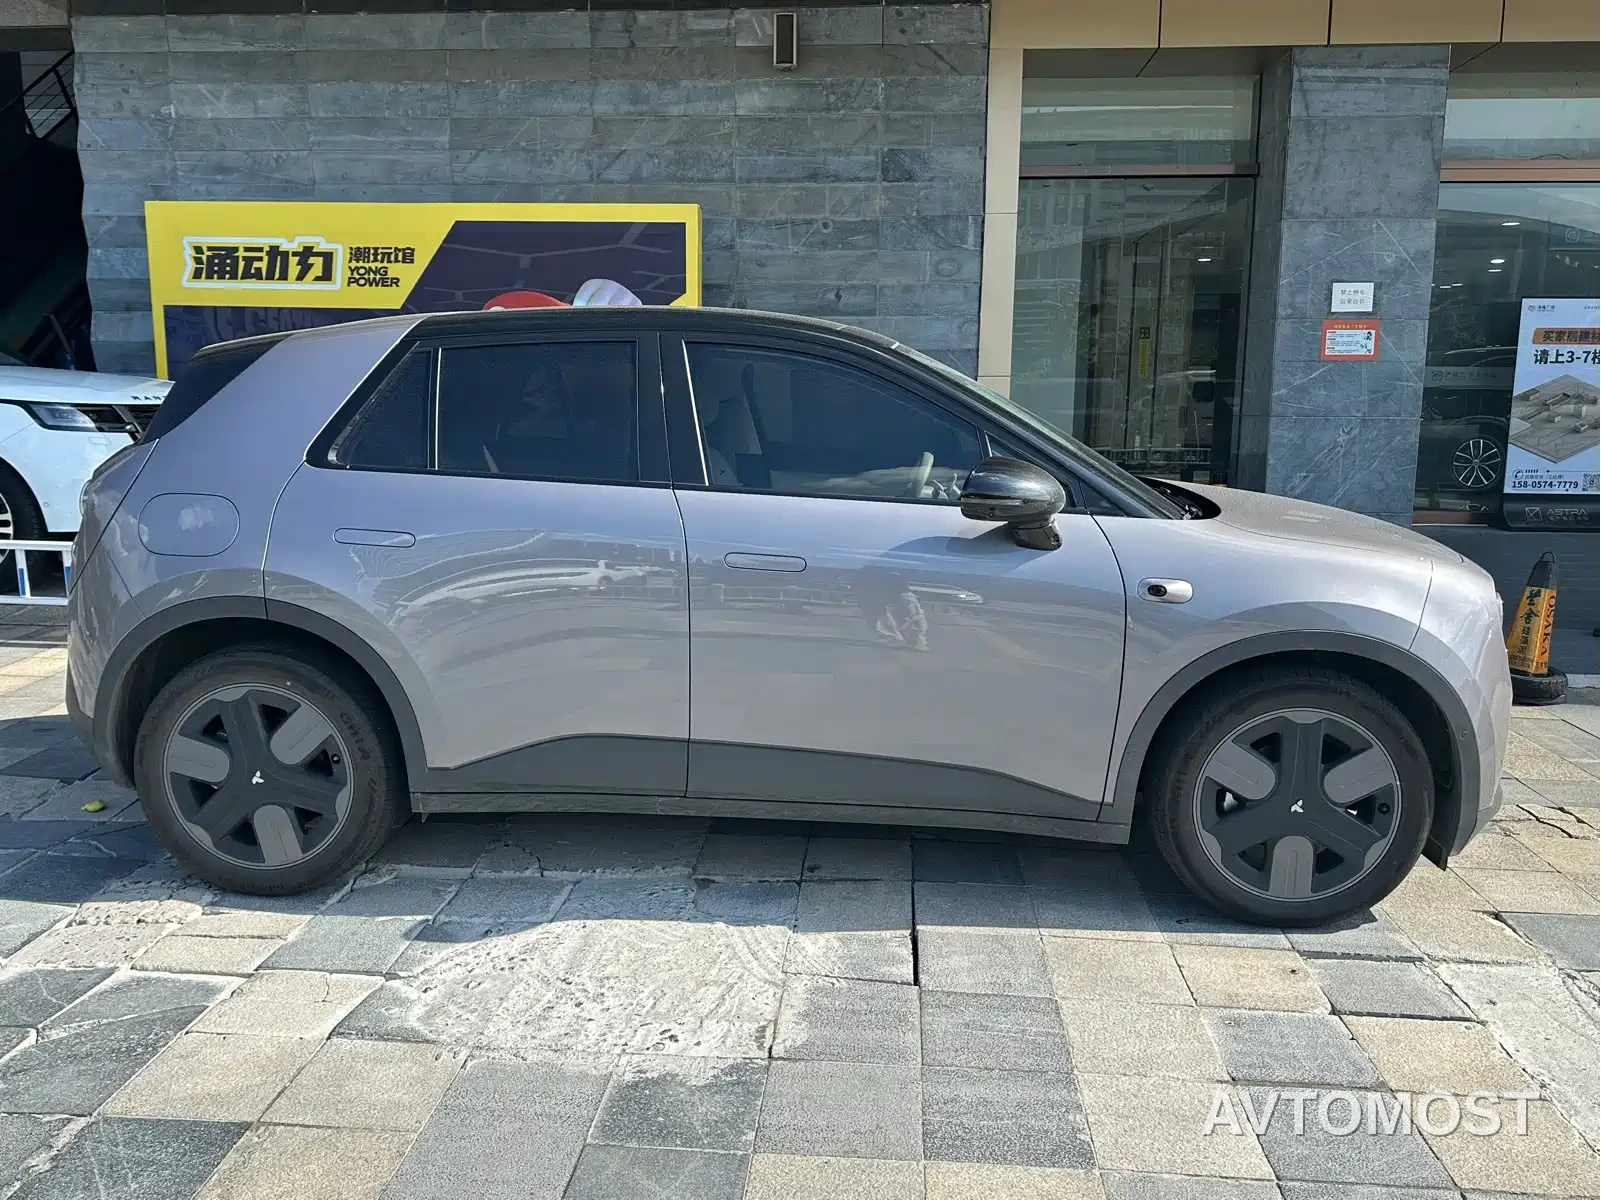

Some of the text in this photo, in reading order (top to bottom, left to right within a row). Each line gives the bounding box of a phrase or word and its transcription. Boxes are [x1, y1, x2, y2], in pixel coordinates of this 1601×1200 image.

[348, 246, 416, 264] 潮玩馆
[191, 245, 334, 282] 涌动力
[348, 266, 388, 276] YONG
[347, 277, 400, 287] POWER
[1511, 481, 1579, 489] 158-0574-7779
[1546, 508, 1588, 516] ASTRA
[1540, 595, 1556, 656] OSAKA
